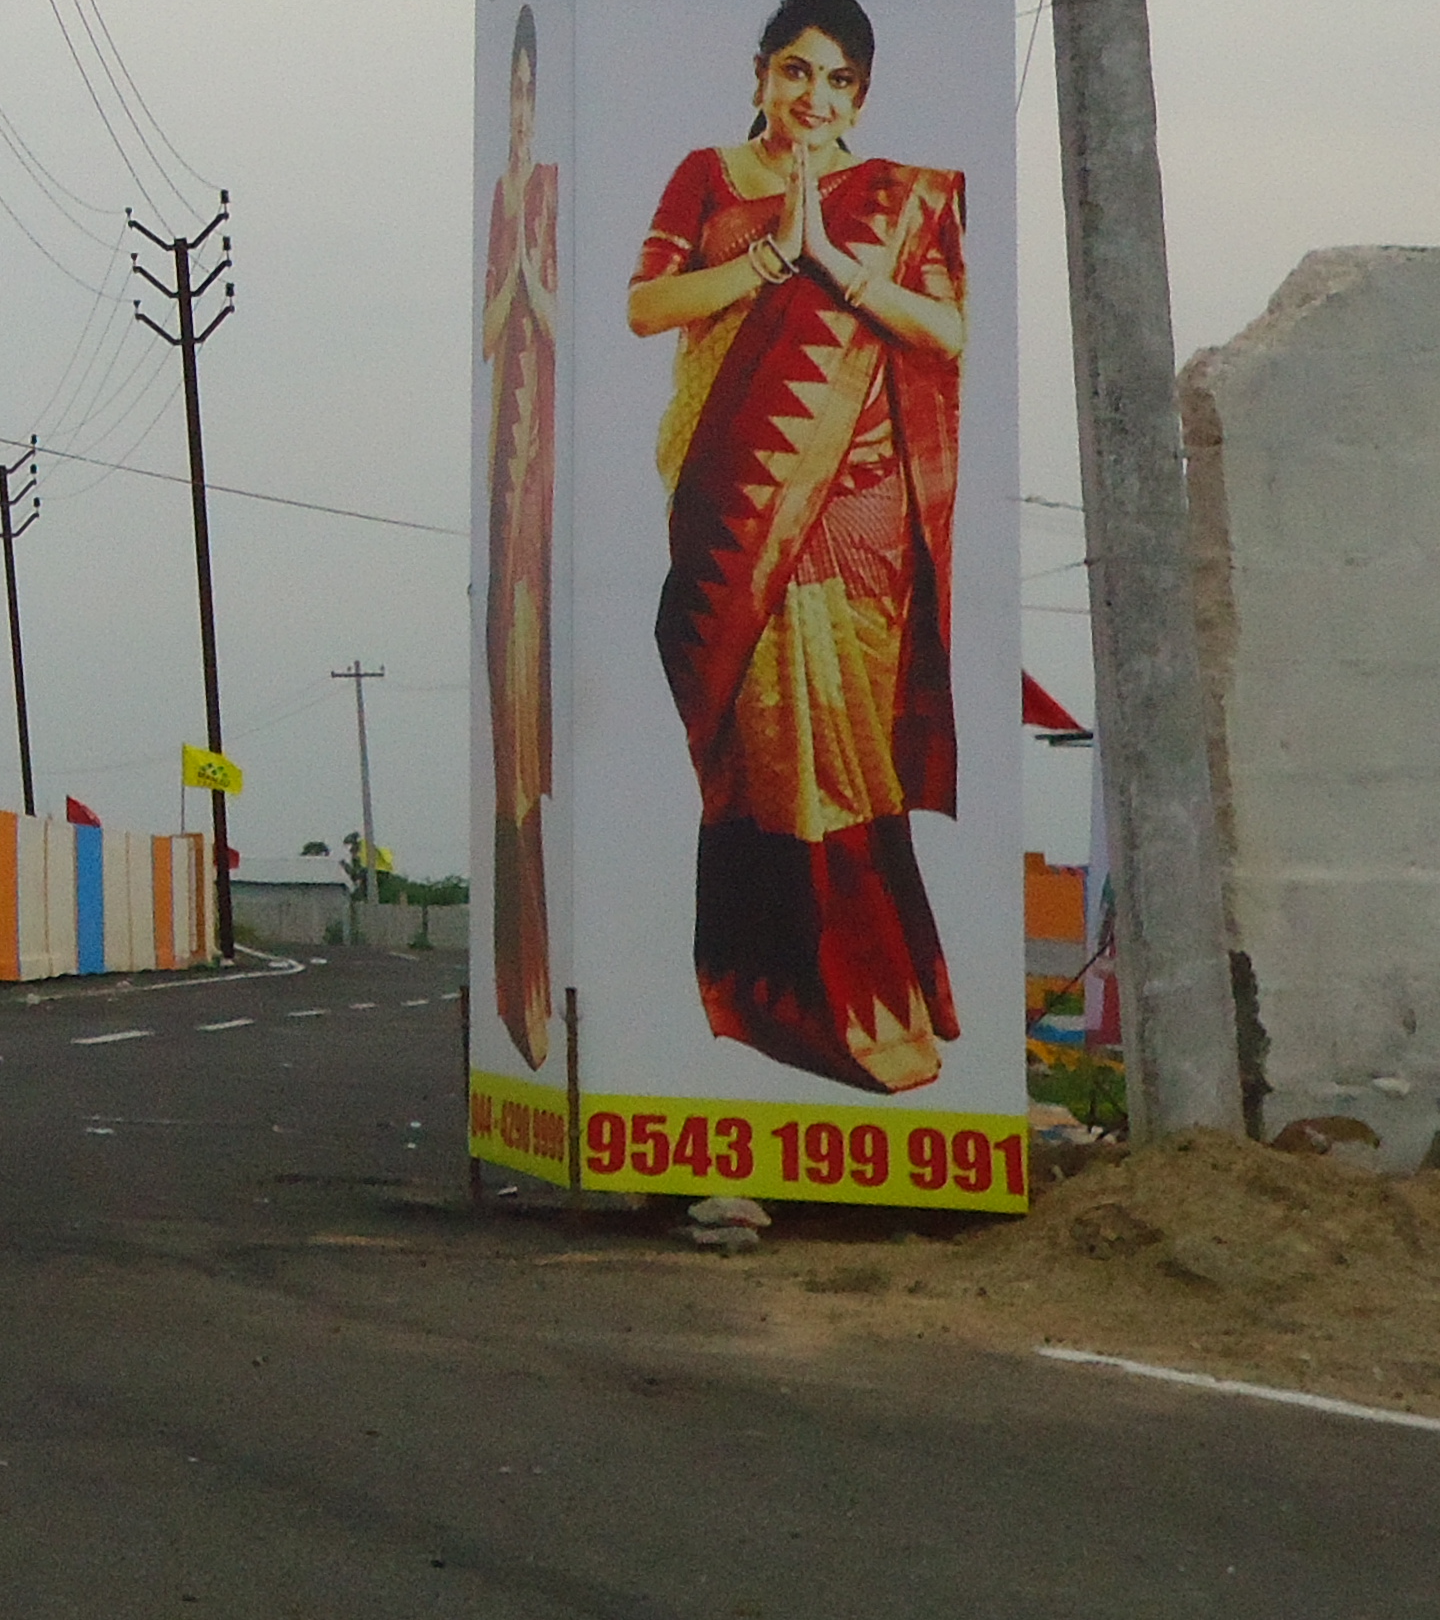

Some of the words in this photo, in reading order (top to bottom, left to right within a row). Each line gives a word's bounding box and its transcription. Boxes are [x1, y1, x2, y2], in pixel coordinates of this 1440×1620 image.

[586, 1112, 754, 1180] 9543
[772, 1121, 889, 1187] 199
[908, 1127, 1025, 1197] 991
